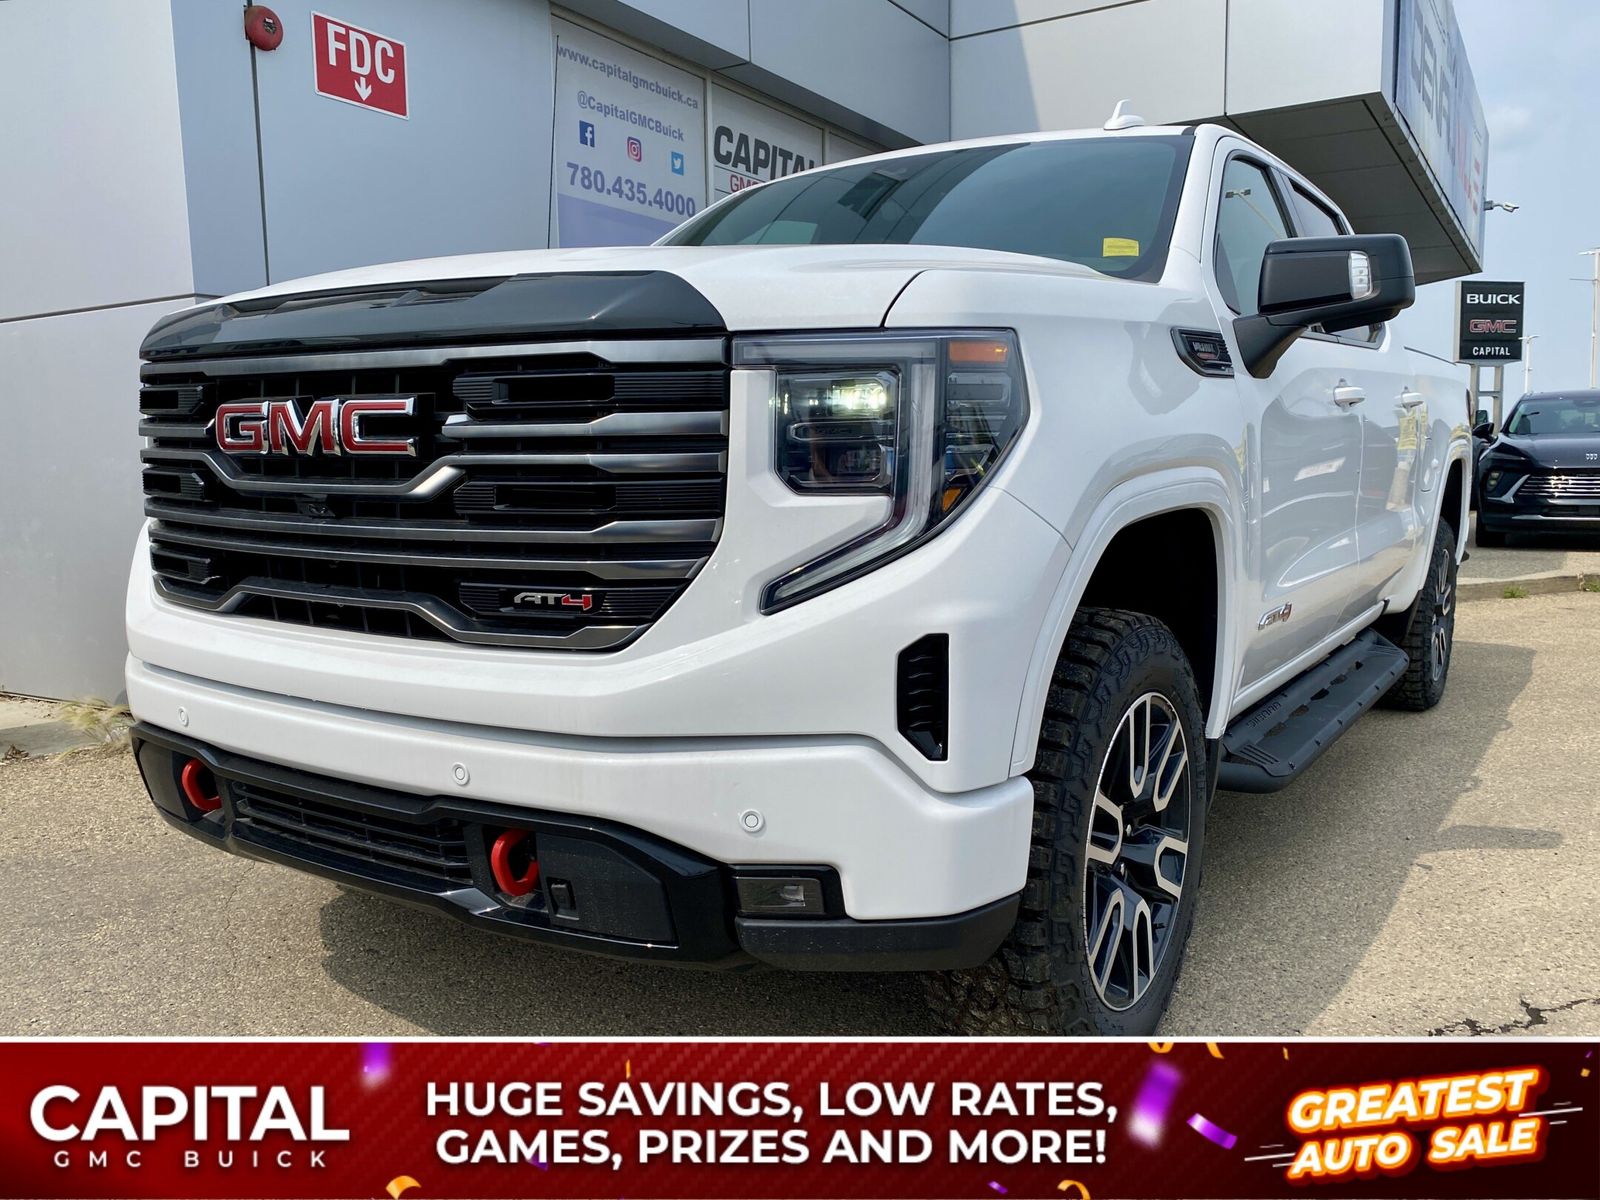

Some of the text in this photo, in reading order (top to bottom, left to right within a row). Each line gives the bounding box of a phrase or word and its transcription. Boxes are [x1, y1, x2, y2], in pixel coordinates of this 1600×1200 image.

[327, 22, 395, 84] FDC
[557, 45, 699, 109] www.capitalgmcbuick.ca
[577, 90, 684, 141] @CapitalGMCBuick
[566, 161, 696, 218] 780.435.4000
[730, 174, 759, 193] GM
[1466, 294, 1520, 304] BUICK
[1469, 319, 1516, 333] GMC
[1472, 346, 1511, 356] CAPITAL
[215, 397, 417, 456] GMC
[513, 592, 593, 611] AT4
